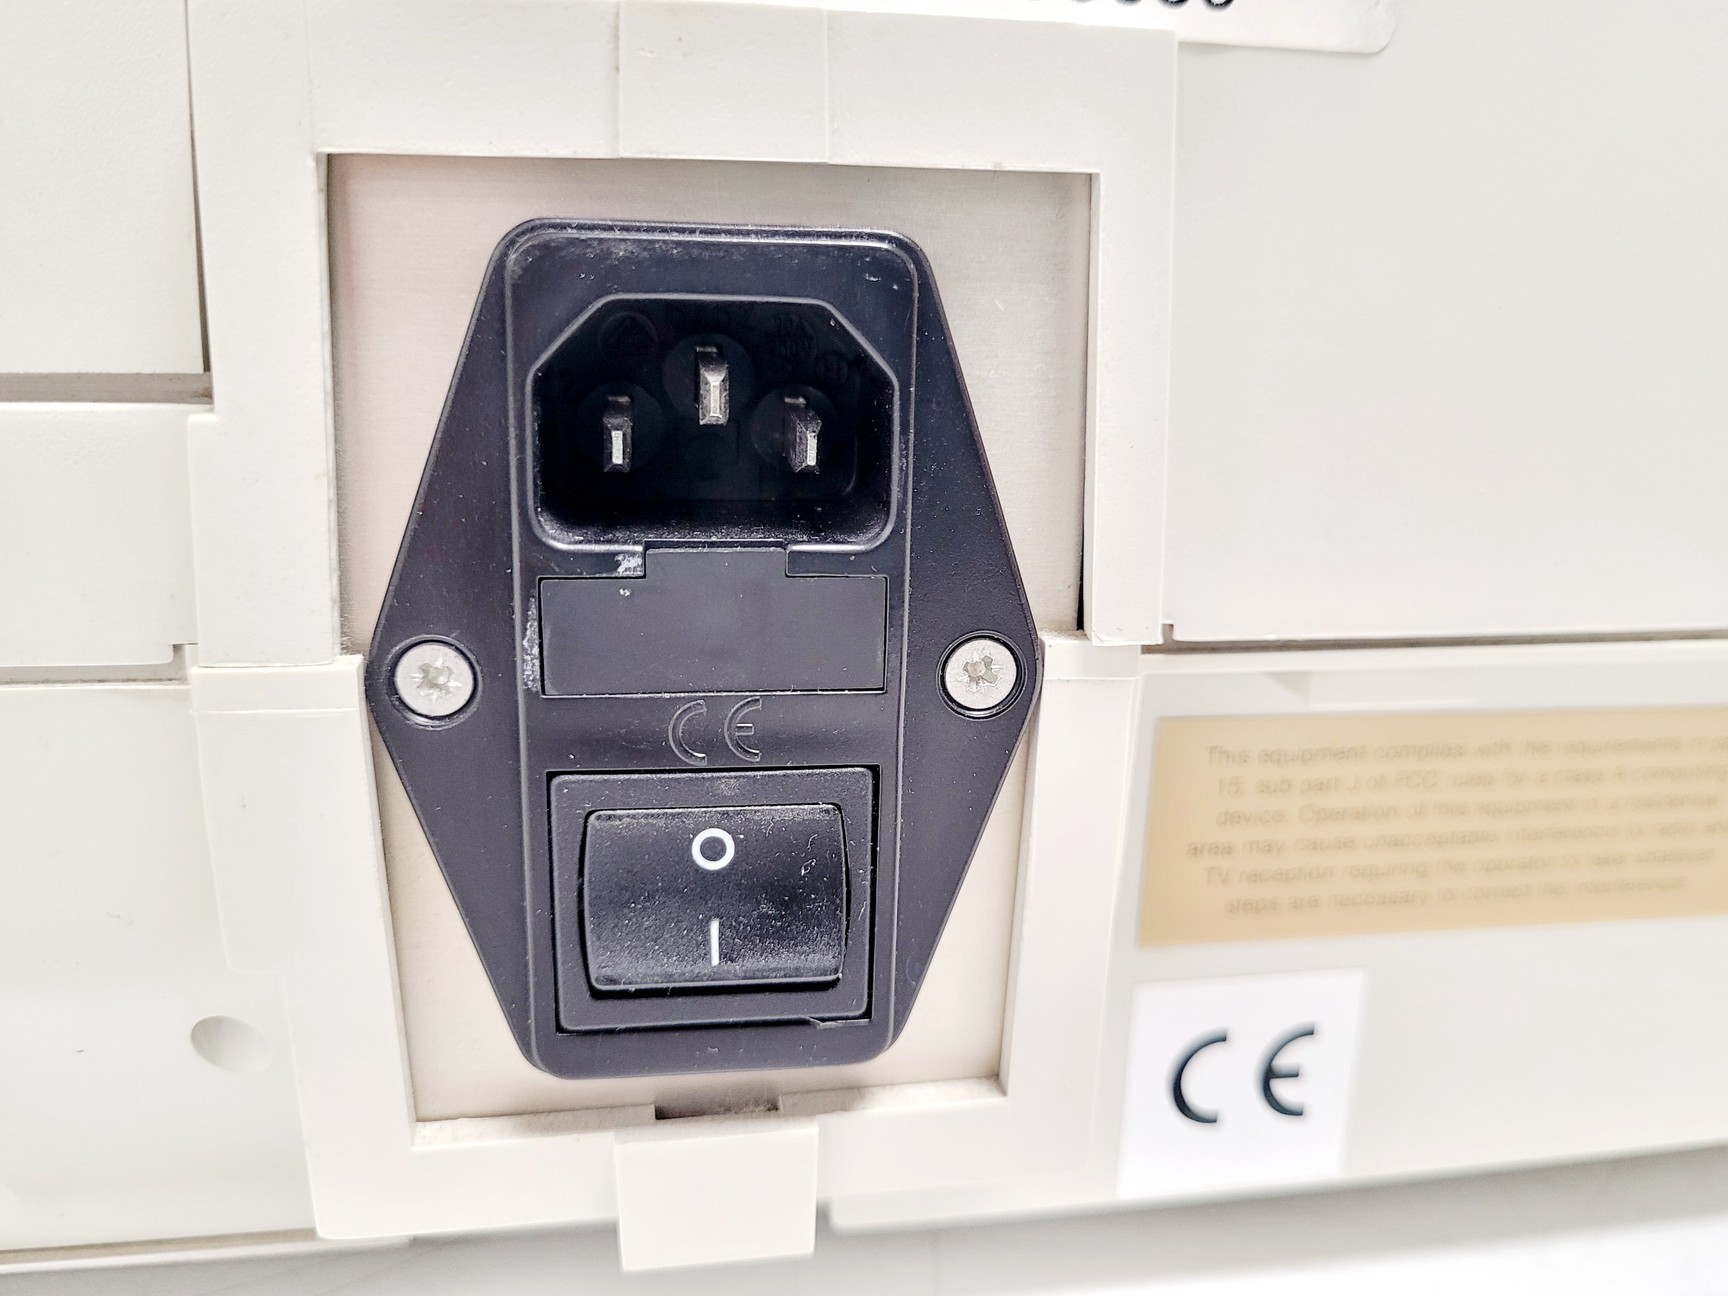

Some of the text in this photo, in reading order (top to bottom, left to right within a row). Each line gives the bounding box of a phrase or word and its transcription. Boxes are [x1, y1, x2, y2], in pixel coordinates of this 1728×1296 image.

[668, 696, 763, 767] CE
[1206, 745, 1249, 765] This
[1258, 745, 1366, 768] equipment
[1167, 1021, 1317, 1123] CE
